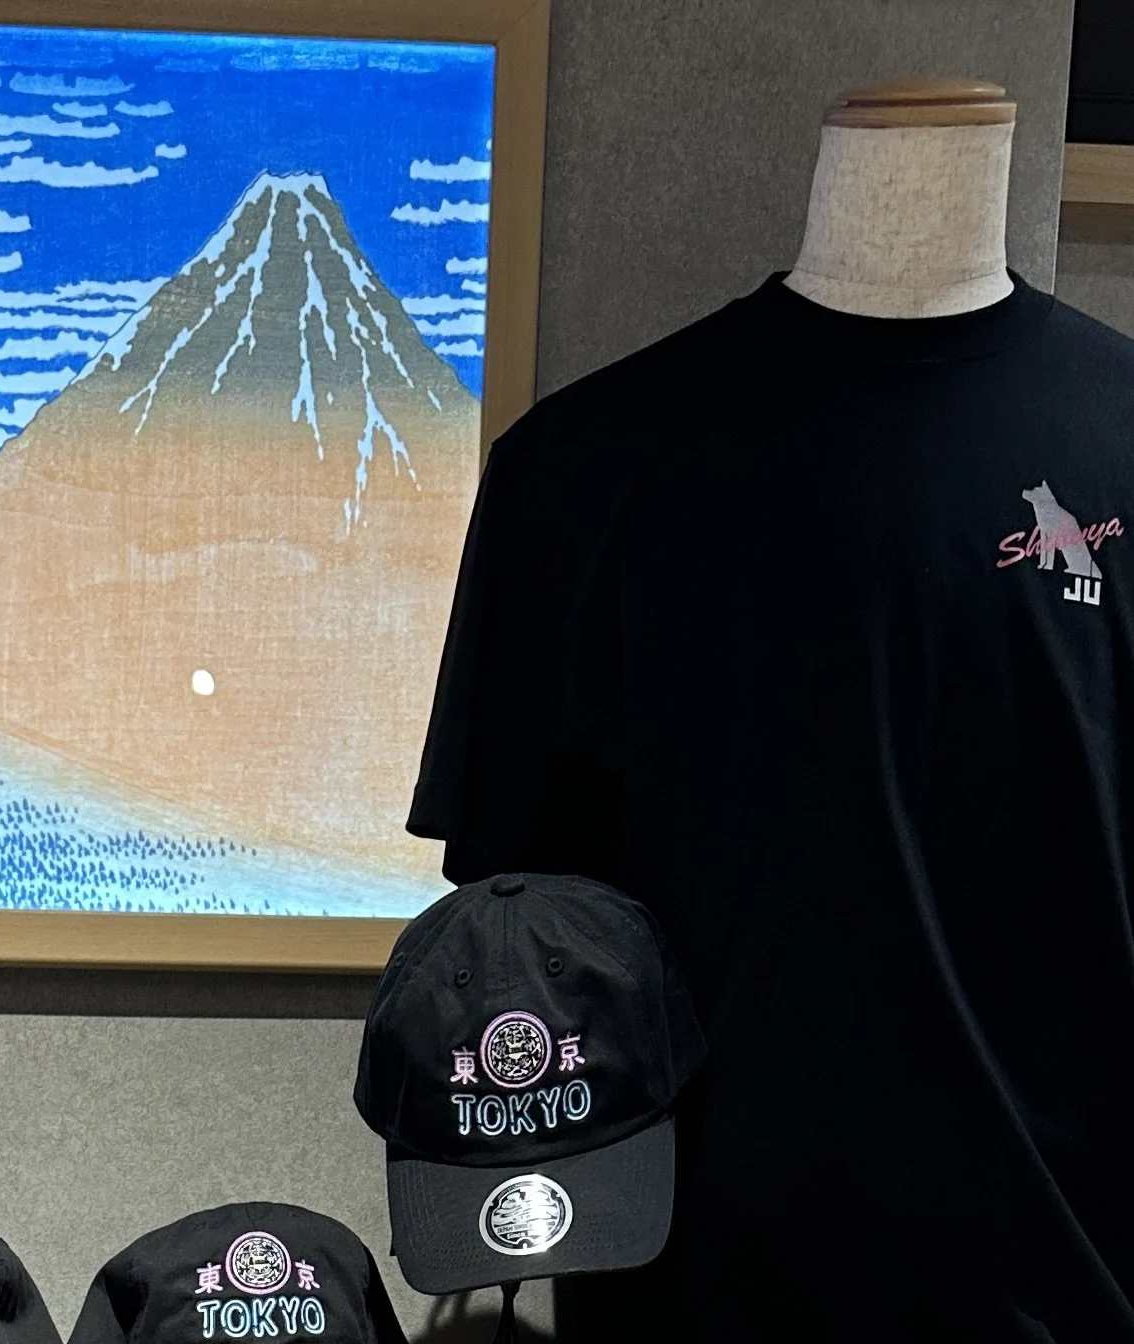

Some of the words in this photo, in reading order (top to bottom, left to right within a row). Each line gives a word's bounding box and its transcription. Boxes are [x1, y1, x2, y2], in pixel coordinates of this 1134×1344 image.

[450, 1048, 480, 1085] 東
[556, 1032, 586, 1072] 京
[451, 1079, 591, 1136] TOKYO
[194, 1262, 224, 1294] 東
[294, 1259, 321, 1290] 京
[196, 1295, 326, 1339] TOKYO
